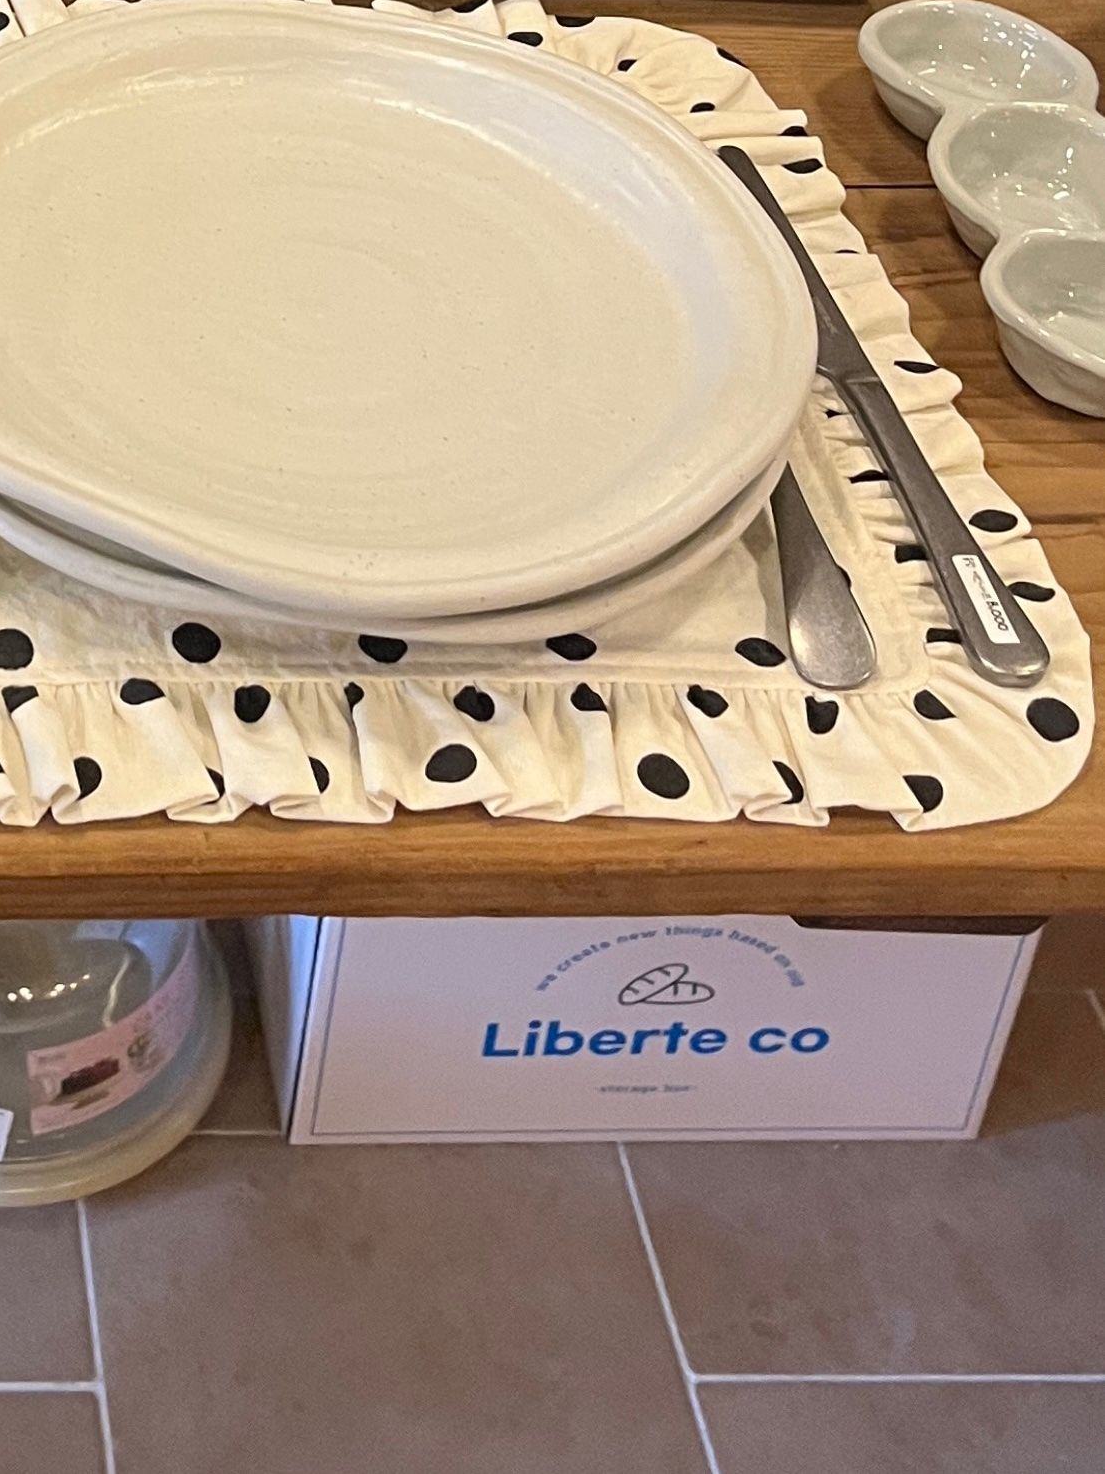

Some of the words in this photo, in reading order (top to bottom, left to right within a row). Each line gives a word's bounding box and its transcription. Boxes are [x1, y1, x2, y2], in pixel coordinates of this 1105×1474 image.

[557, 941, 611, 972] create
[616, 930, 657, 944] new
[665, 926, 723, 938] things
[480, 1019, 728, 1058] Liberte
[748, 1027, 831, 1054] co
